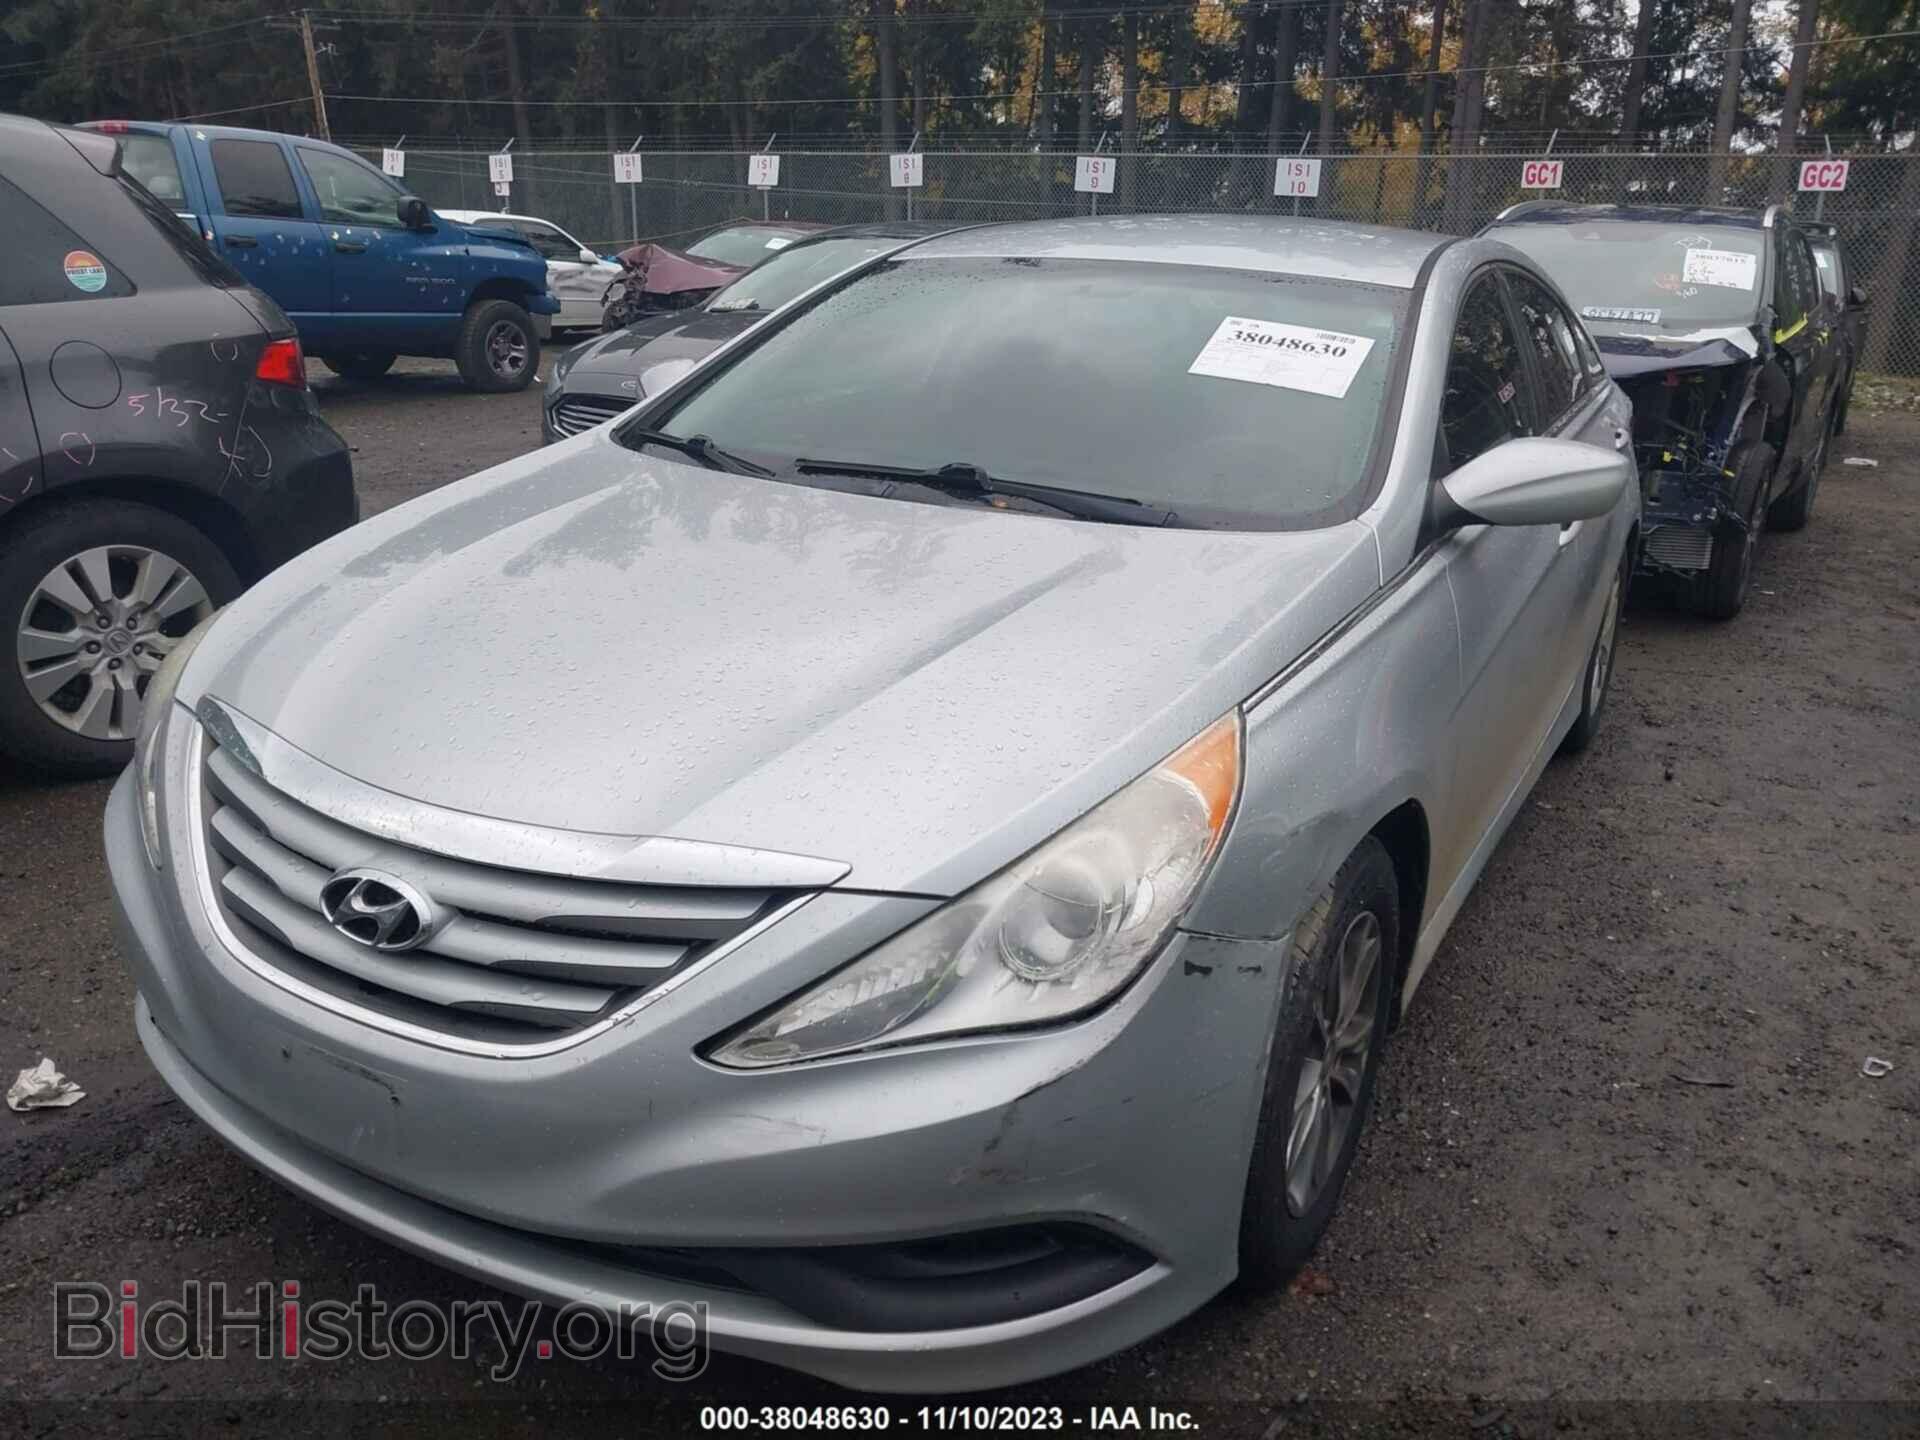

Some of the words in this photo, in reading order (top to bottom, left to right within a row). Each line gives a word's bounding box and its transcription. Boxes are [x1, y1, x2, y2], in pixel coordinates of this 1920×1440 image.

[760, 173, 767, 182] 7
[1525, 163, 1558, 185] GC1
[1803, 164, 1844, 187] GC2
[1291, 181, 1305, 193] 10
[1231, 330, 1347, 358] 38048630
